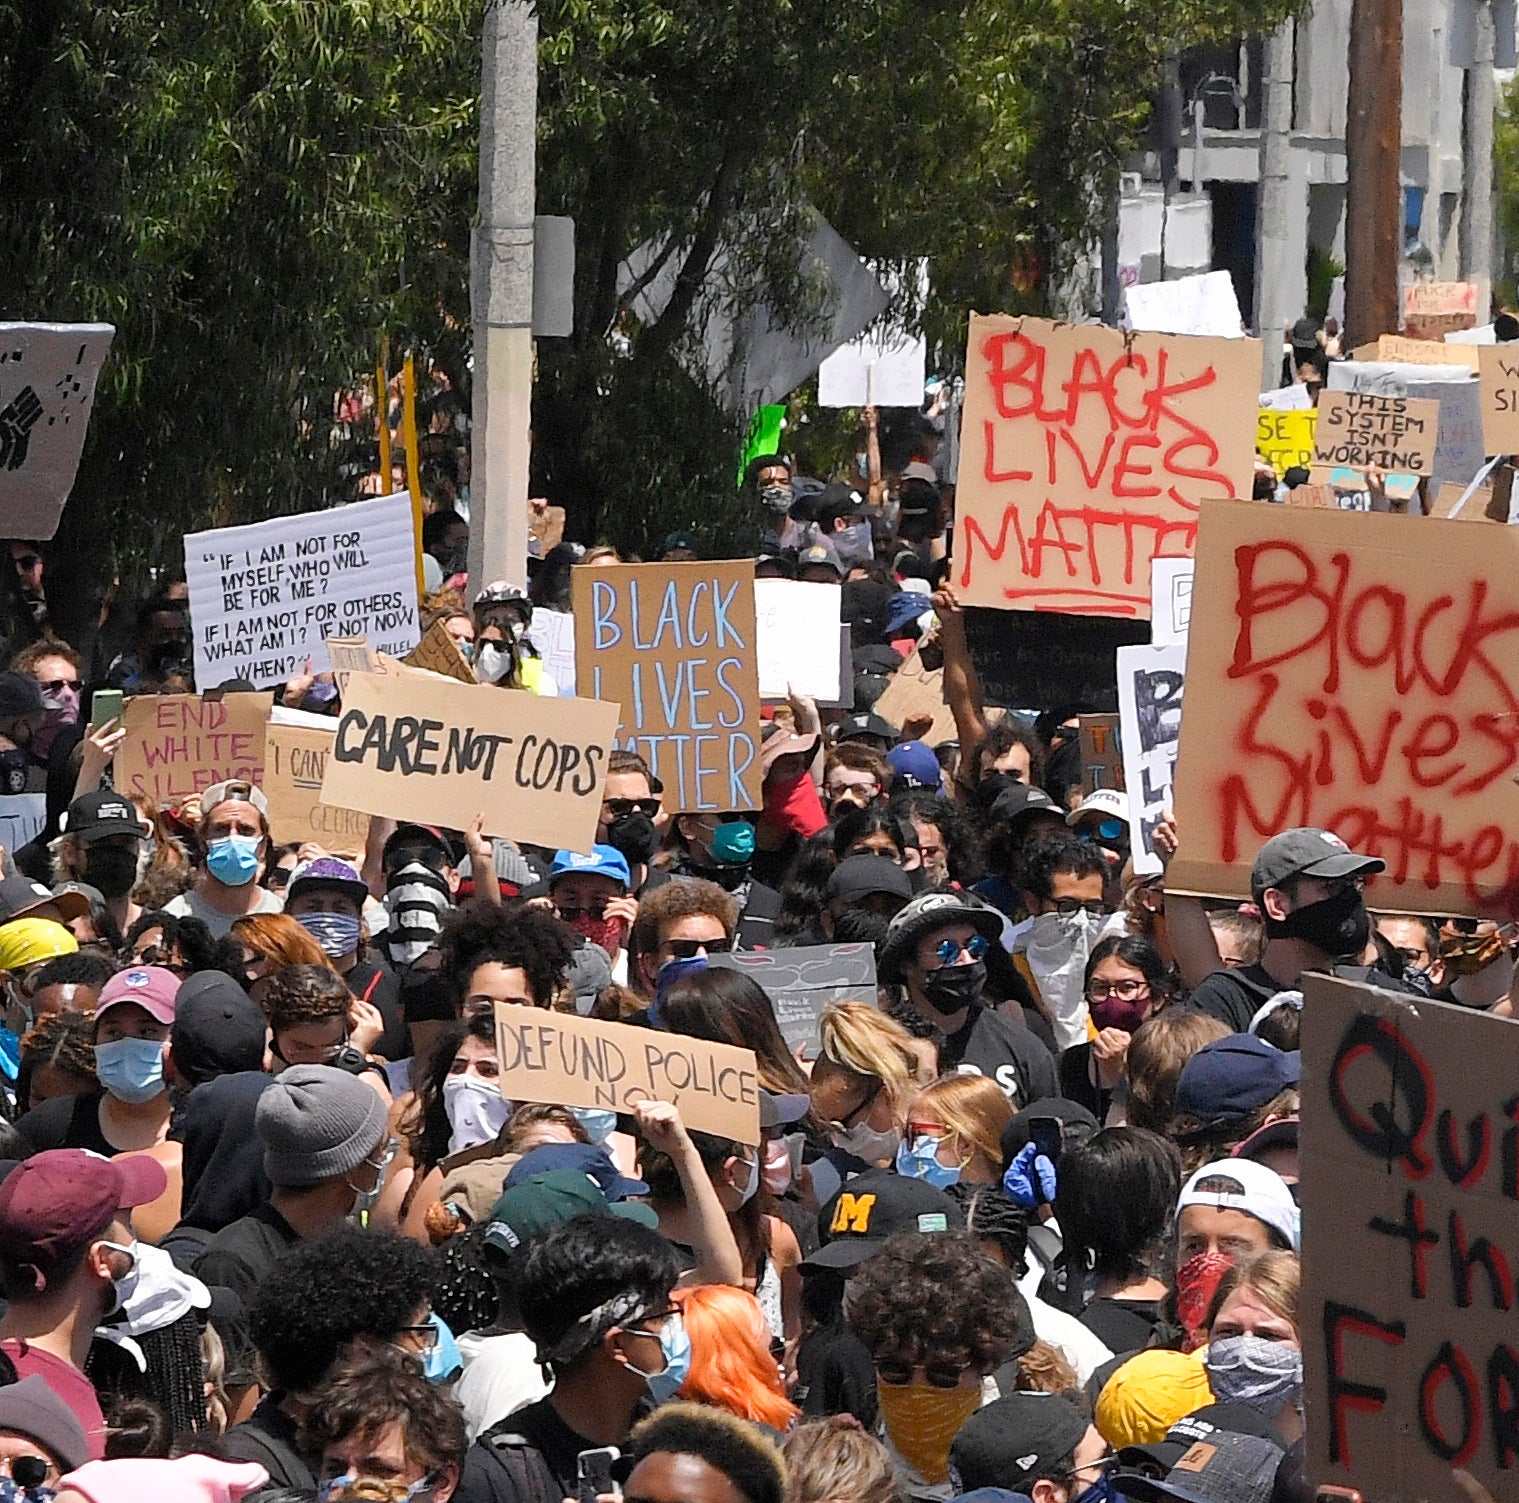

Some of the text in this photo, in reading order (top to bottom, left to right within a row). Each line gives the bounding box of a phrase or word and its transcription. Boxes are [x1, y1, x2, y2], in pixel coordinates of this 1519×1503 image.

[981, 332, 1217, 432] BLACK
[1328, 407, 1425, 434] SYSTEM
[1346, 392, 1407, 413] THIS
[1314, 445, 1424, 471] WORKING
[1344, 431, 1405, 448] ISNT
[984, 419, 1235, 512] LIVES
[245, 531, 360, 566] I AM NOT FOR
[289, 560, 330, 580] WHO
[333, 550, 369, 570] WILL
[205, 624, 218, 642] IF
[224, 622, 229, 640] I
[236, 617, 264, 637] AM
[266, 610, 298, 630] NOT
[305, 603, 337, 623] FOR
[592, 579, 745, 650] BLACK
[203, 638, 253, 662] WHAT
[260, 633, 284, 650] AM
[319, 624, 334, 641] IF
[339, 618, 370, 636] NOT
[374, 608, 414, 633] NOW
[593, 656, 744, 730] LIVES
[157, 702, 228, 730] END
[142, 733, 257, 768] WHITE
[335, 709, 603, 796] CARE NOT COPS
[501, 1022, 756, 1106] DEFUND POLICE
